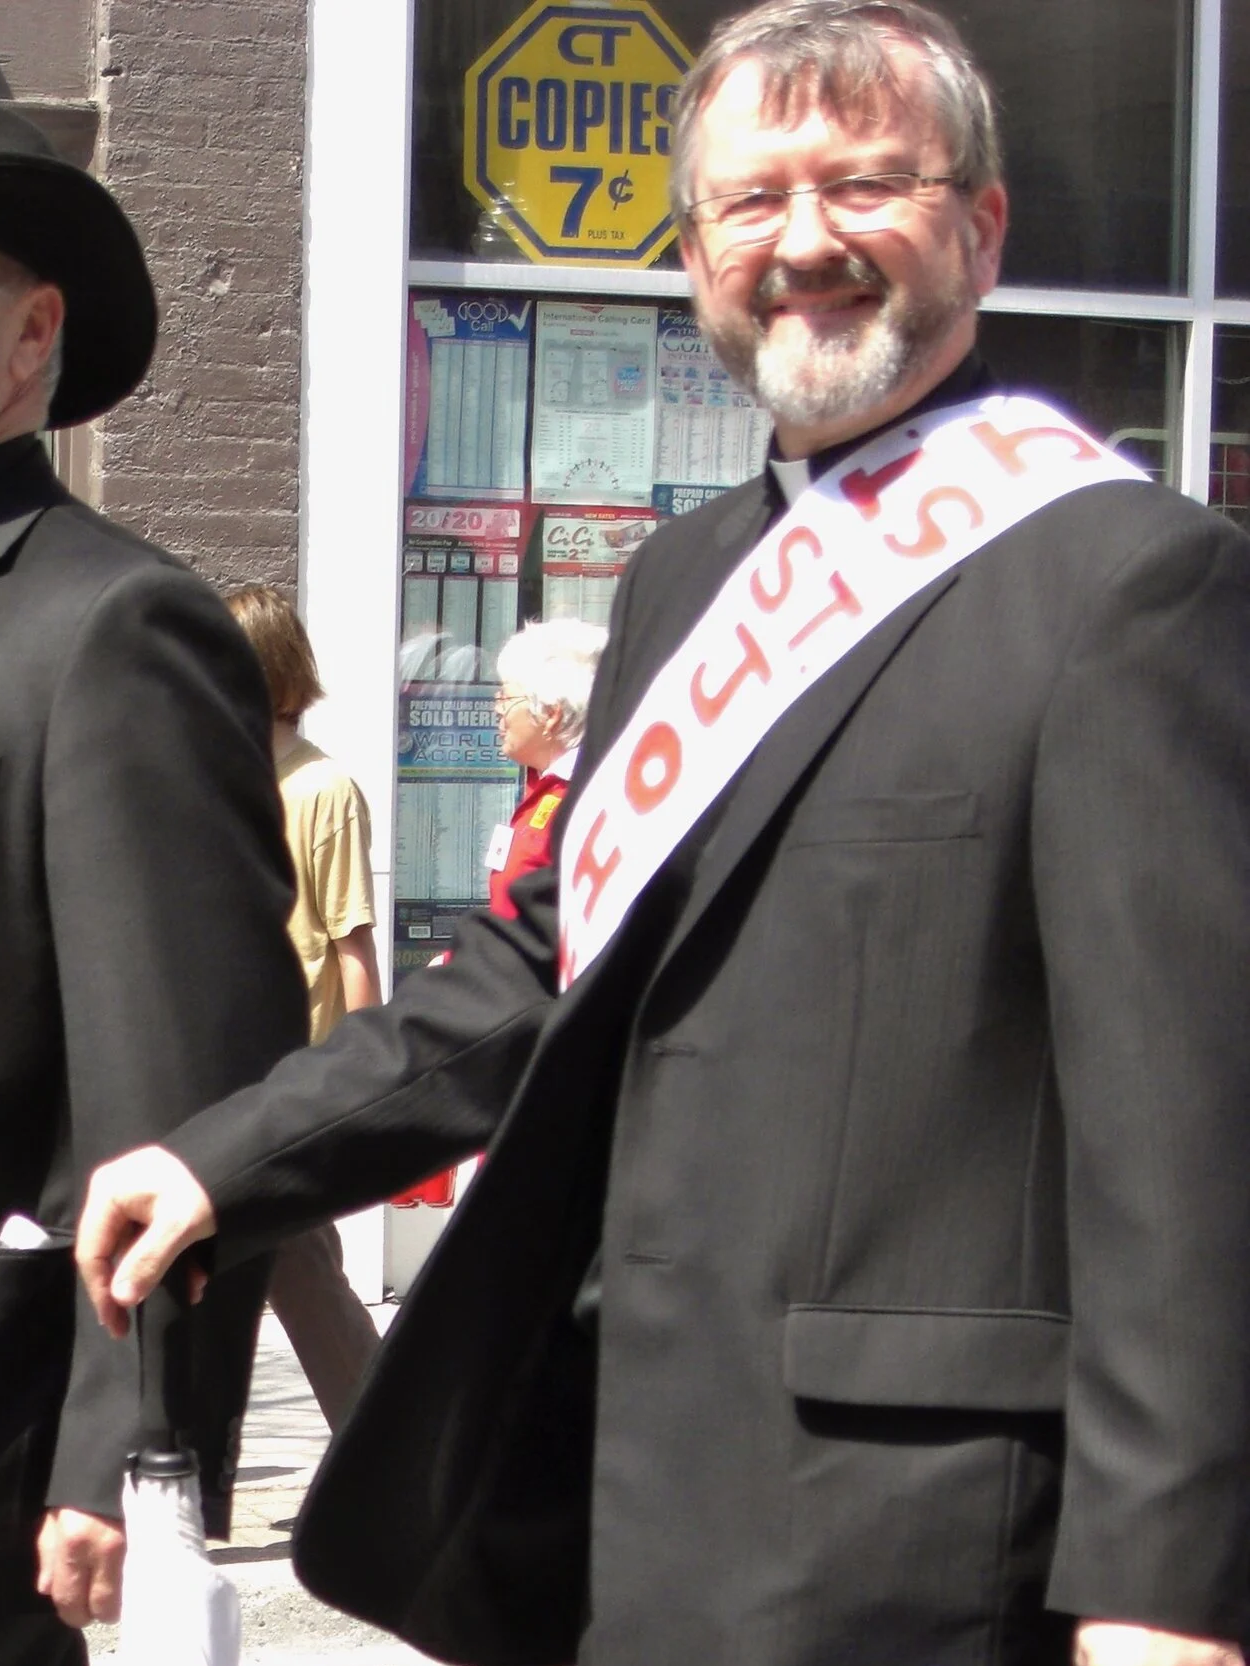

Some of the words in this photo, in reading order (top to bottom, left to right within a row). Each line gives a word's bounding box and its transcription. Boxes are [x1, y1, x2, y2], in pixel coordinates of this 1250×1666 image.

[557, 24, 632, 67] CT
[497, 76, 680, 157] COPIES
[587, 229, 607, 239] PLUS
[610, 230, 626, 240] TAX
[457, 301, 509, 323] GOOD
[470, 320, 495, 332] Call
[630, 316, 651, 325] Card
[410, 510, 483, 530] 20/20
[474, 701, 496, 711] CARD
[409, 710, 453, 726] SOLD
[458, 711, 499, 727] HERE
[414, 749, 509, 762] ACCESS
